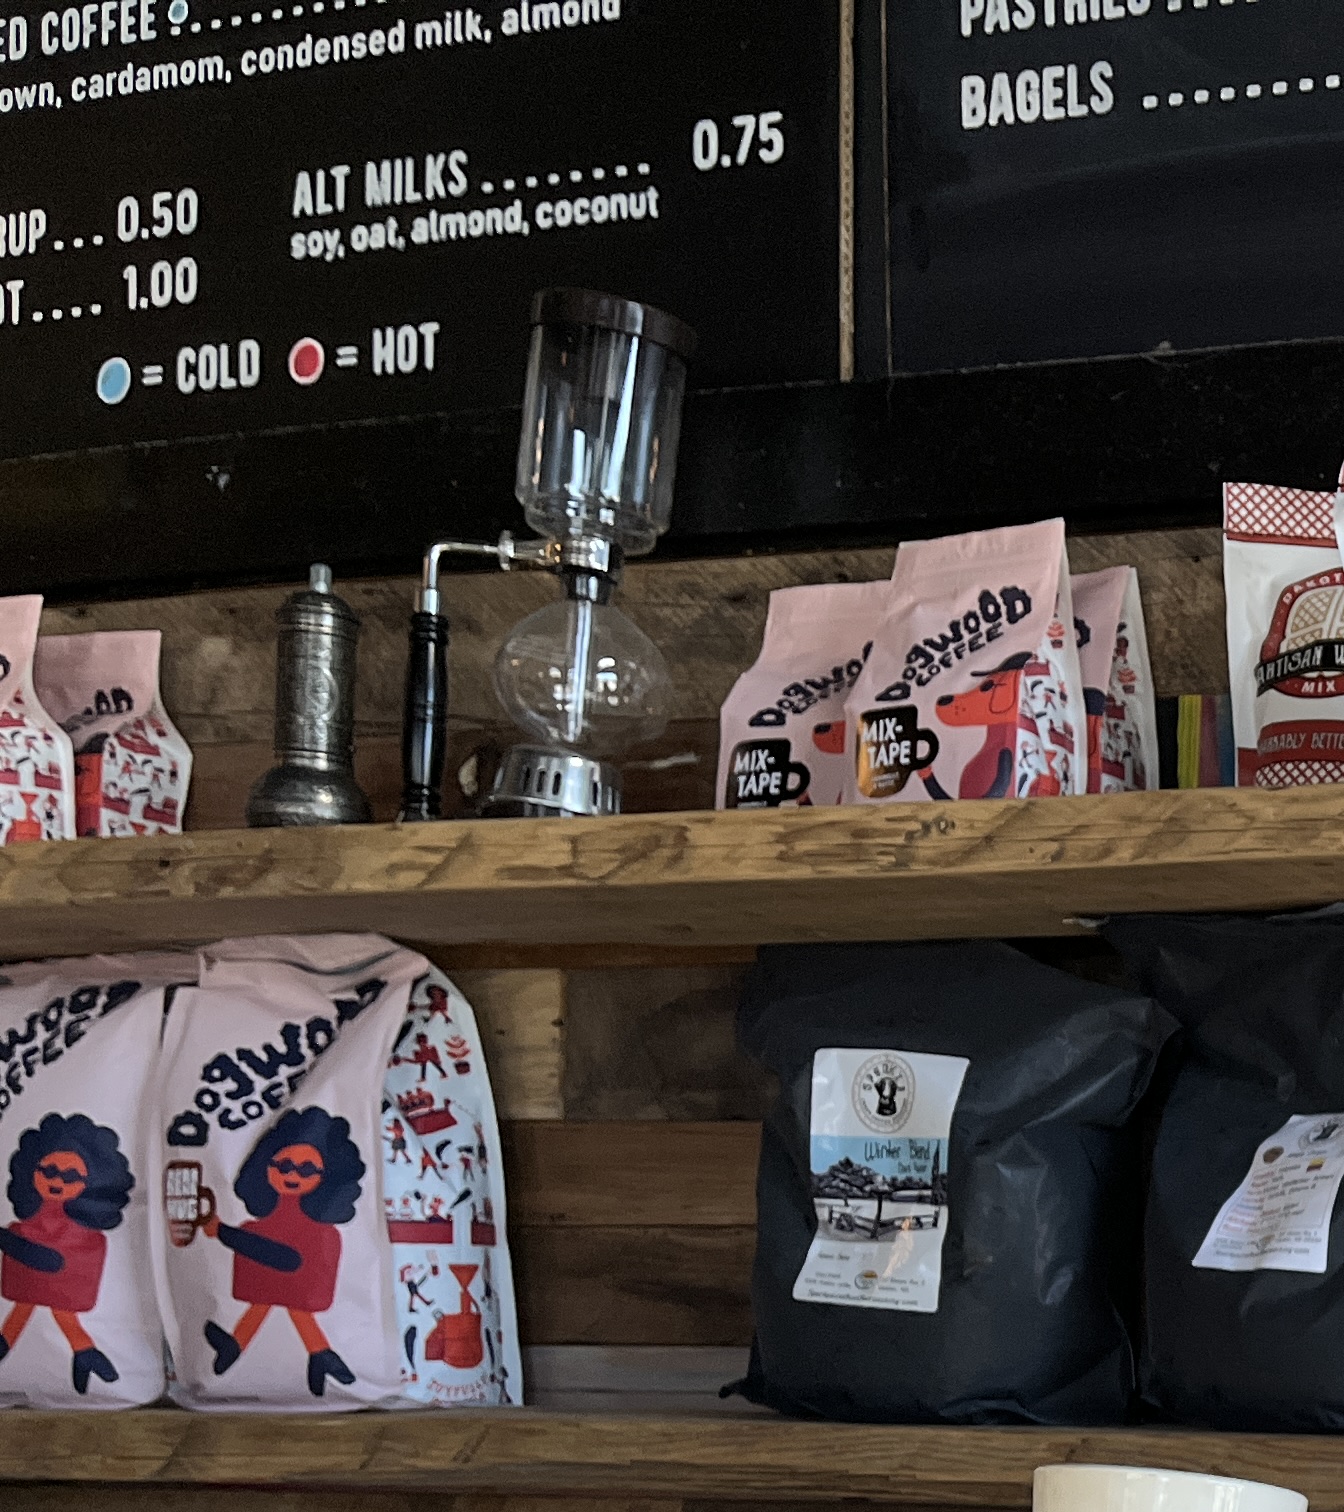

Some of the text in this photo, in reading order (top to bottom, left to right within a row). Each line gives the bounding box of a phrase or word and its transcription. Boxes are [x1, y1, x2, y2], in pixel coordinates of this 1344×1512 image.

[42, 0, 157, 55] COFFEE
[71, 58, 231, 101] cardamom,
[241, 19, 405, 76] condensed
[414, 8, 492, 50] milk,
[501, 0, 621, 36] almond
[961, 60, 1114, 130] BAGELS
[292, 110, 784, 218] ALT MILKS 0.75
[117, 187, 199, 243] 0.50
[290, 186, 659, 262] soy, oat, almond, coconut
[123, 256, 198, 310] 1.00
[176, 338, 260, 394] COLD
[372, 322, 440, 376] HOT
[914, 621, 1004, 688] COFFEE
[1300, 680, 1337, 693] MIX
[861, 716, 904, 744] MIX-
[866, 739, 911, 769] TAPE
[733, 749, 776, 775] MIX-
[737, 771, 783, 798] TAPE
